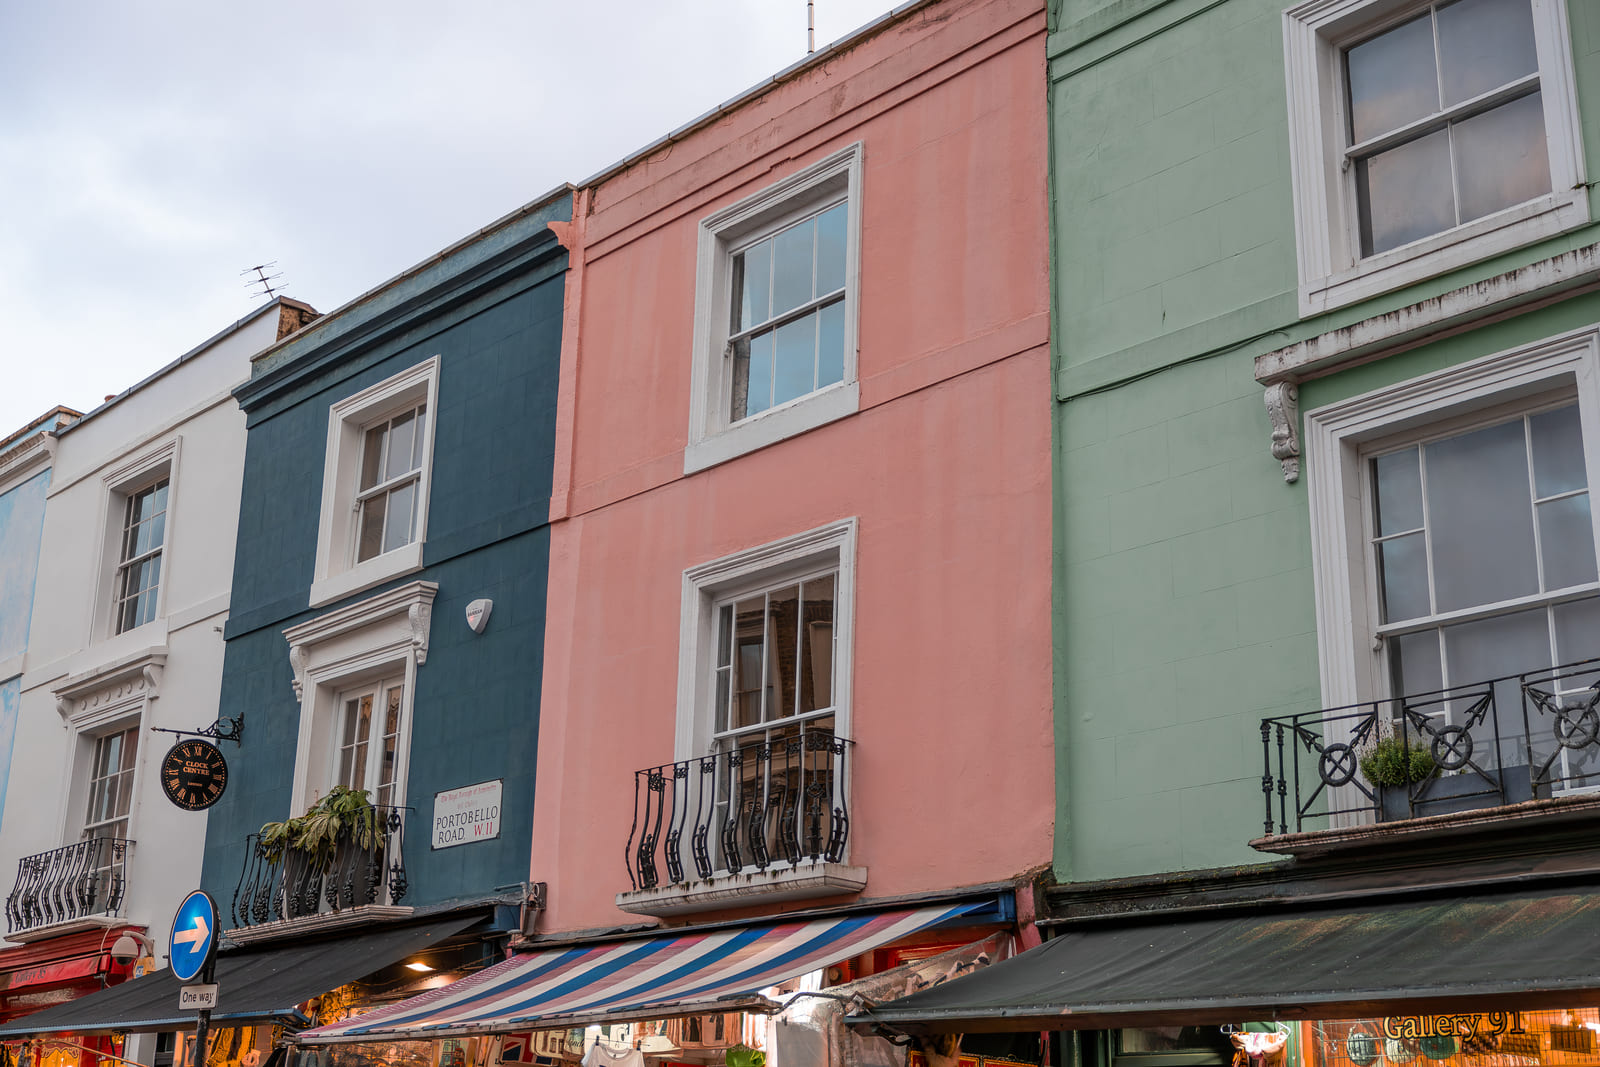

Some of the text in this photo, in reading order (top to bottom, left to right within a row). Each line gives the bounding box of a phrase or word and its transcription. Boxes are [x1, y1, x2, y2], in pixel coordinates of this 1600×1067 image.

[186, 760, 208, 769] CLOCK
[183, 767, 210, 776] CENTRE
[436, 806, 498, 830] PORTOBELLO
[182, 992, 214, 1004] One way
[1383, 1011, 1525, 1042] Gallery 91
